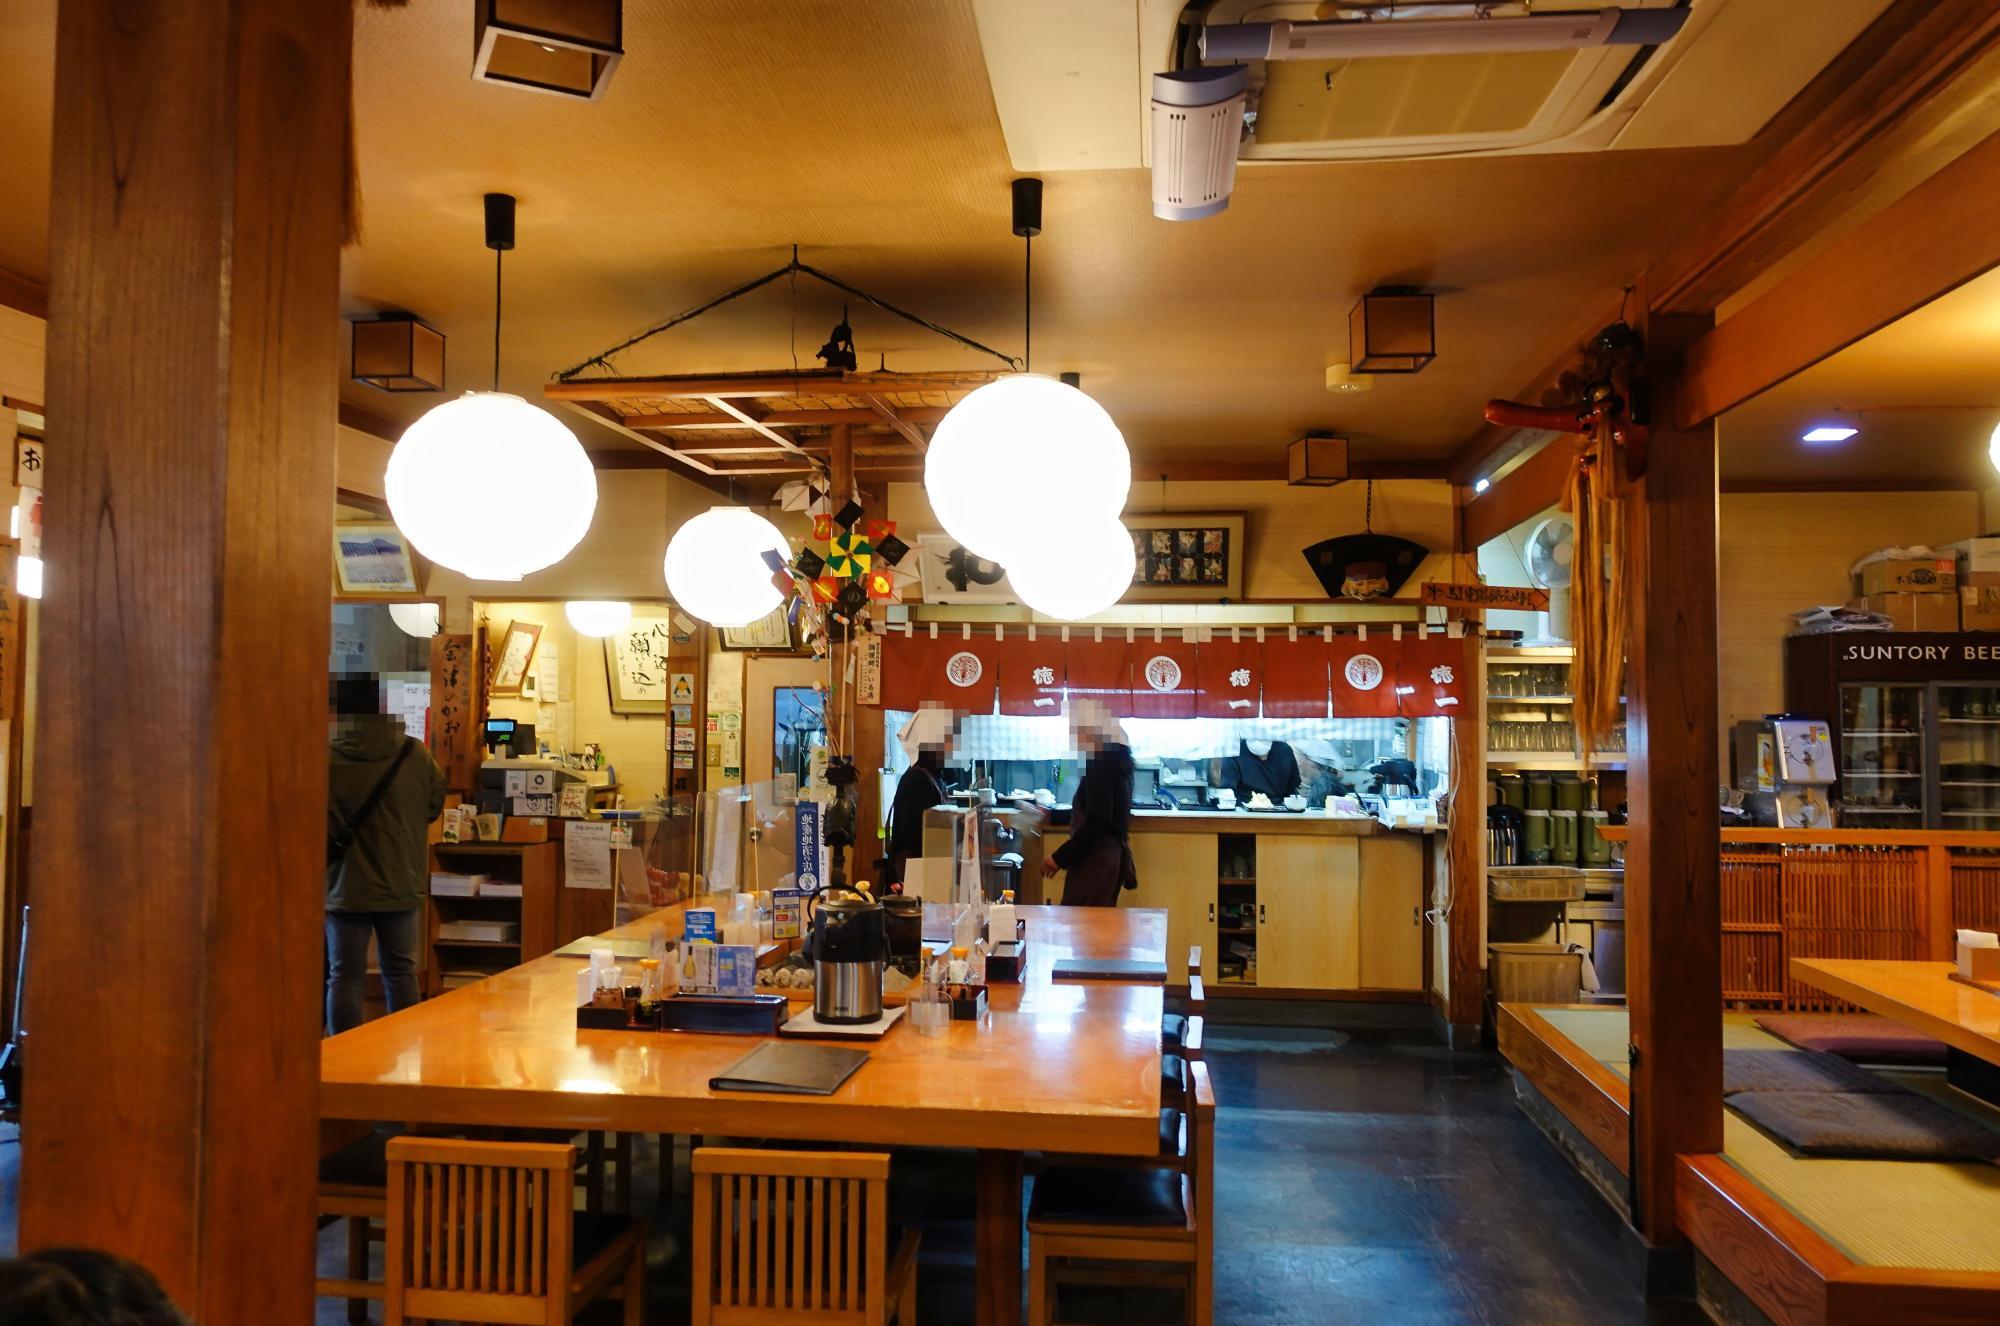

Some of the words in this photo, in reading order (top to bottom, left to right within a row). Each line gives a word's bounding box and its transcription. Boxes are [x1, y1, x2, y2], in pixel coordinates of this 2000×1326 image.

[1848, 645, 1950, 660] SUNTORY
[1032, 666, 1055, 708] 徳一
[1229, 668, 1251, 710] 徳一
[1430, 664, 1459, 708] 徳一
